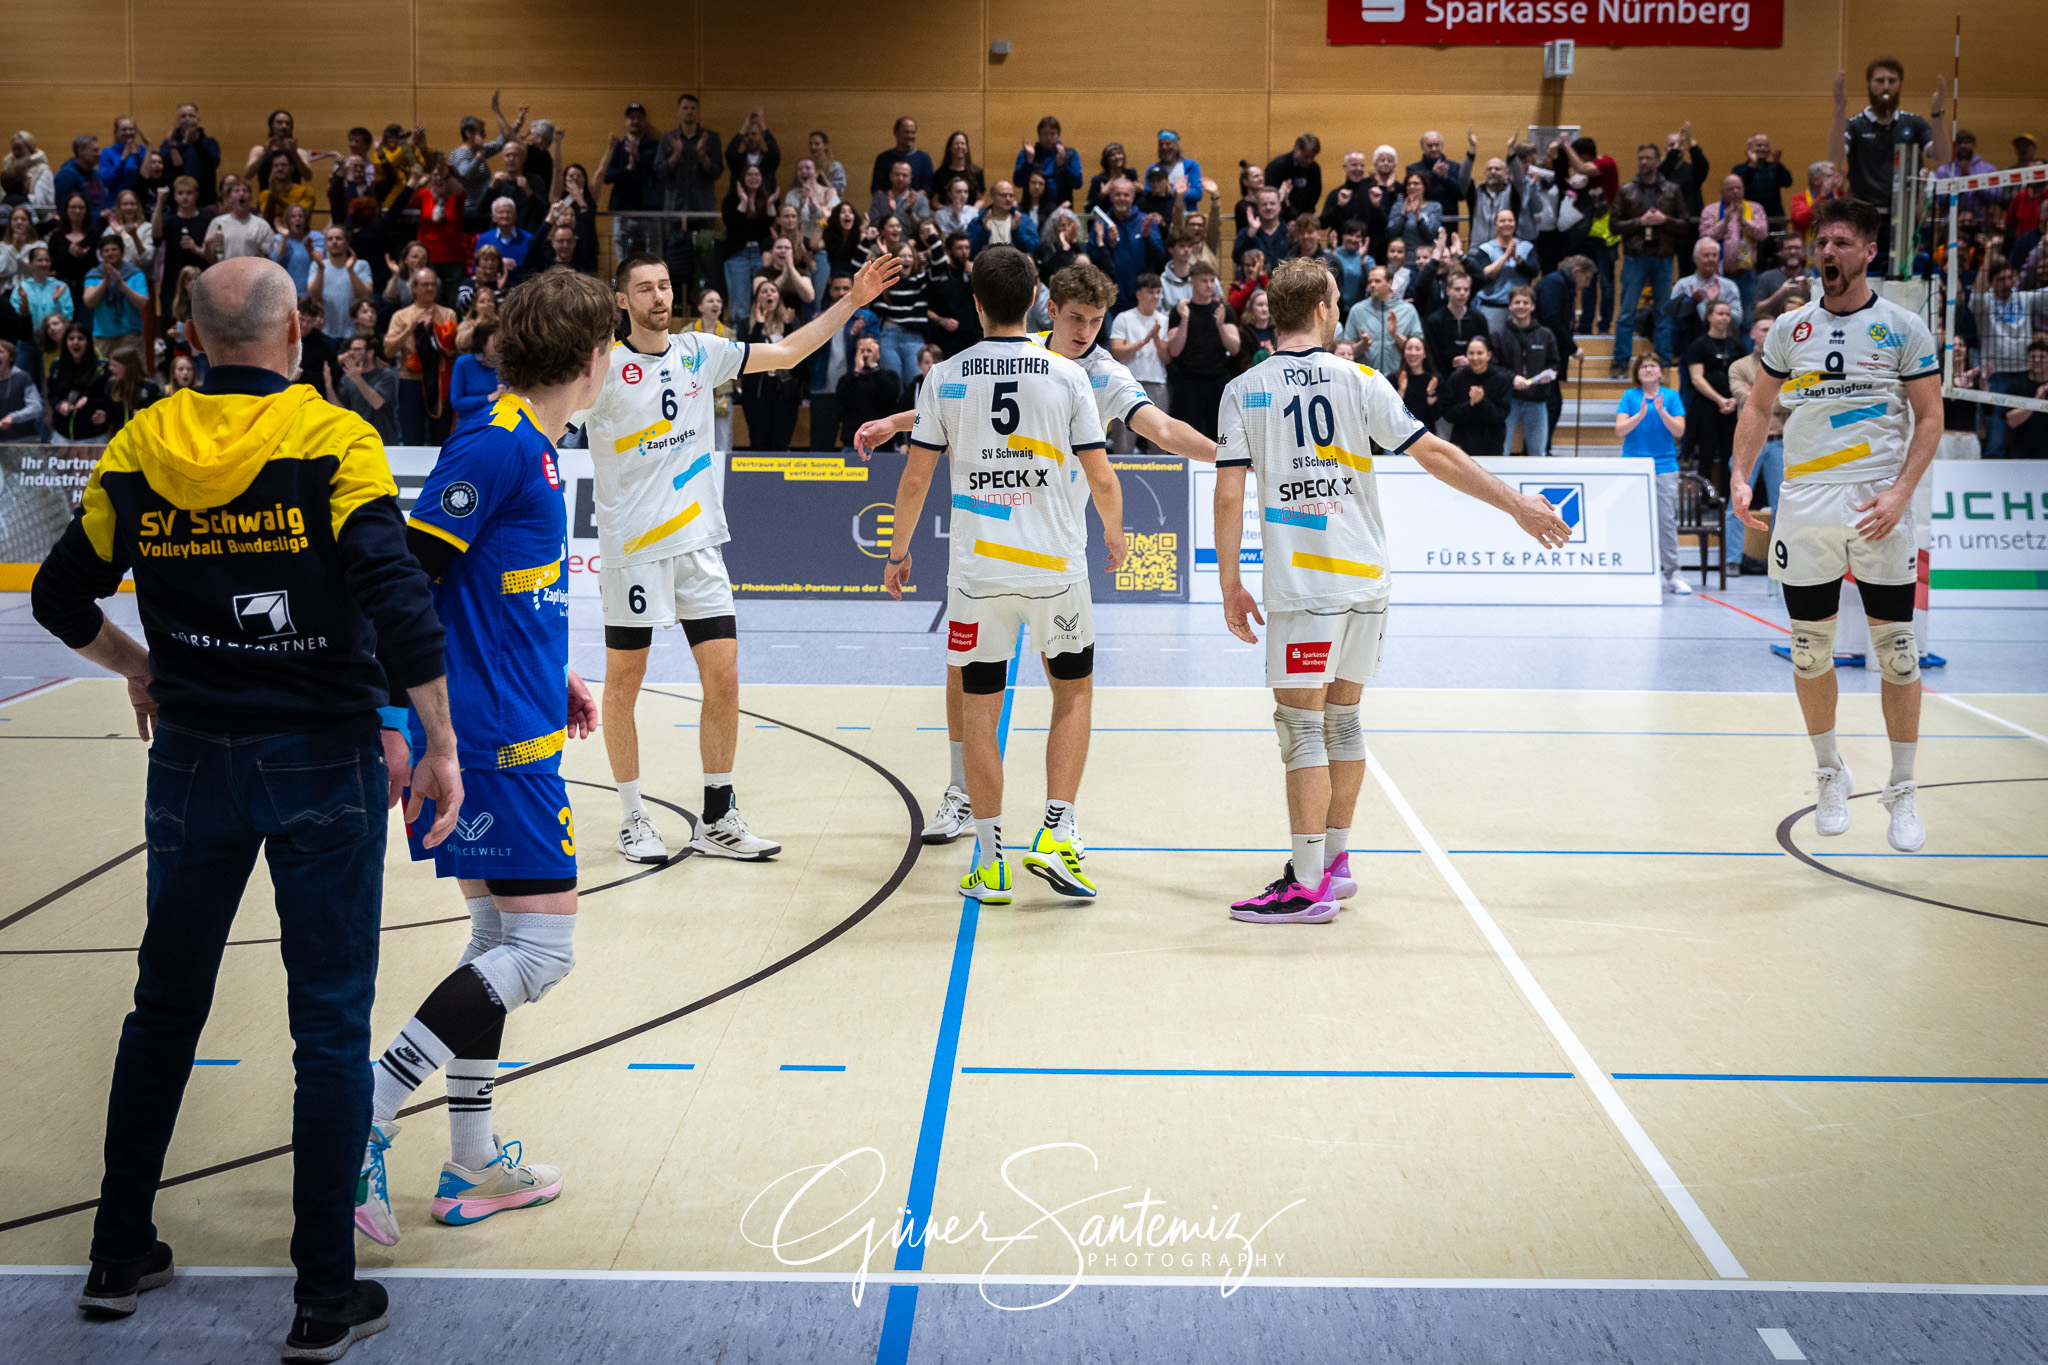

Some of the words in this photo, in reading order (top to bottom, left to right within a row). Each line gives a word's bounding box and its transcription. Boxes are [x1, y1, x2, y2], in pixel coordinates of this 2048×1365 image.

[1425, 0, 1588, 30] Sparkasse
[1598, 0, 1750, 31] Nürnberg
[962, 357, 1049, 377] BIBELRIETHER
[1283, 367, 1331, 386] ROLL
[1804, 387, 1826, 398] Zapf
[662, 389, 678, 421] 6
[990, 381, 1020, 435] 5
[1283, 394, 1335, 448] 10
[647, 438, 668, 451] Zapf
[982, 449, 993, 460] SV
[996, 447, 1034, 460] Schwaig
[21, 456, 44, 470] Ihr
[48, 456, 98, 471] Partne
[777, 460, 792, 468] auf
[794, 460, 808, 468] die
[810, 461, 842, 469] Sonne,
[1292, 457, 1304, 470] SV
[969, 469, 1030, 490] SPECK
[1279, 478, 1340, 502] SPECK
[970, 491, 1032, 511] pumpen
[140, 510, 177, 537] SV
[190, 503, 305, 535] Schwaig
[1281, 500, 1344, 524] pumpen
[139, 541, 224, 559] Volleyball
[227, 536, 309, 553] Bundesliga
[1959, 530, 2048, 551] umsetz
[1427, 548, 1496, 567] FÜRST
[1502, 551, 1515, 566] &
[1522, 551, 1623, 567] PARTNER
[1775, 540, 1788, 569] 9
[741, 583, 841, 592] Photovoltaik-Partner
[843, 584, 860, 592] aus
[862, 583, 878, 592] der
[628, 584, 647, 614] 6
[558, 806, 575, 856] 3
[401, 1045, 423, 1063] NIKE
